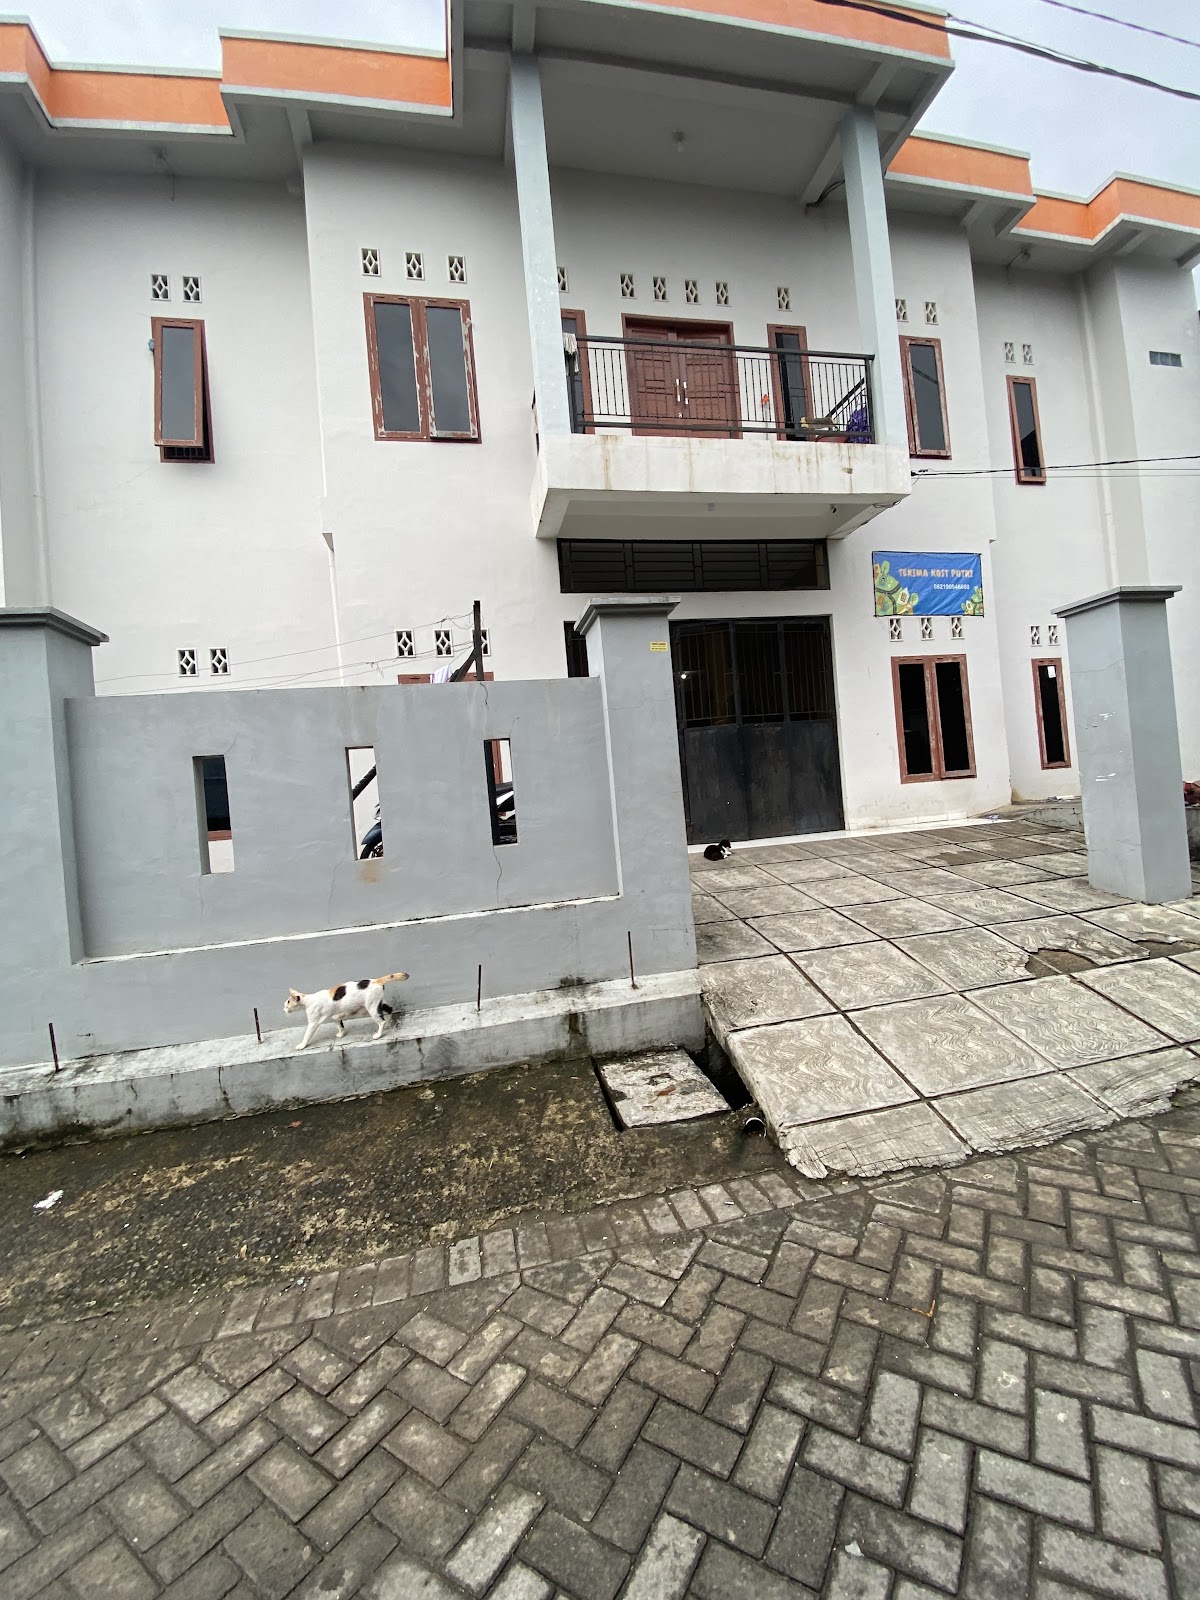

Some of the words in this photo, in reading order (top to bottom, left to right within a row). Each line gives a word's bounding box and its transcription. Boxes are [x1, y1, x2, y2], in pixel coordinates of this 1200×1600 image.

[898, 568, 929, 577] TERIMA
[931, 569, 949, 578] KOST
[950, 569, 974, 578] PUTRI
